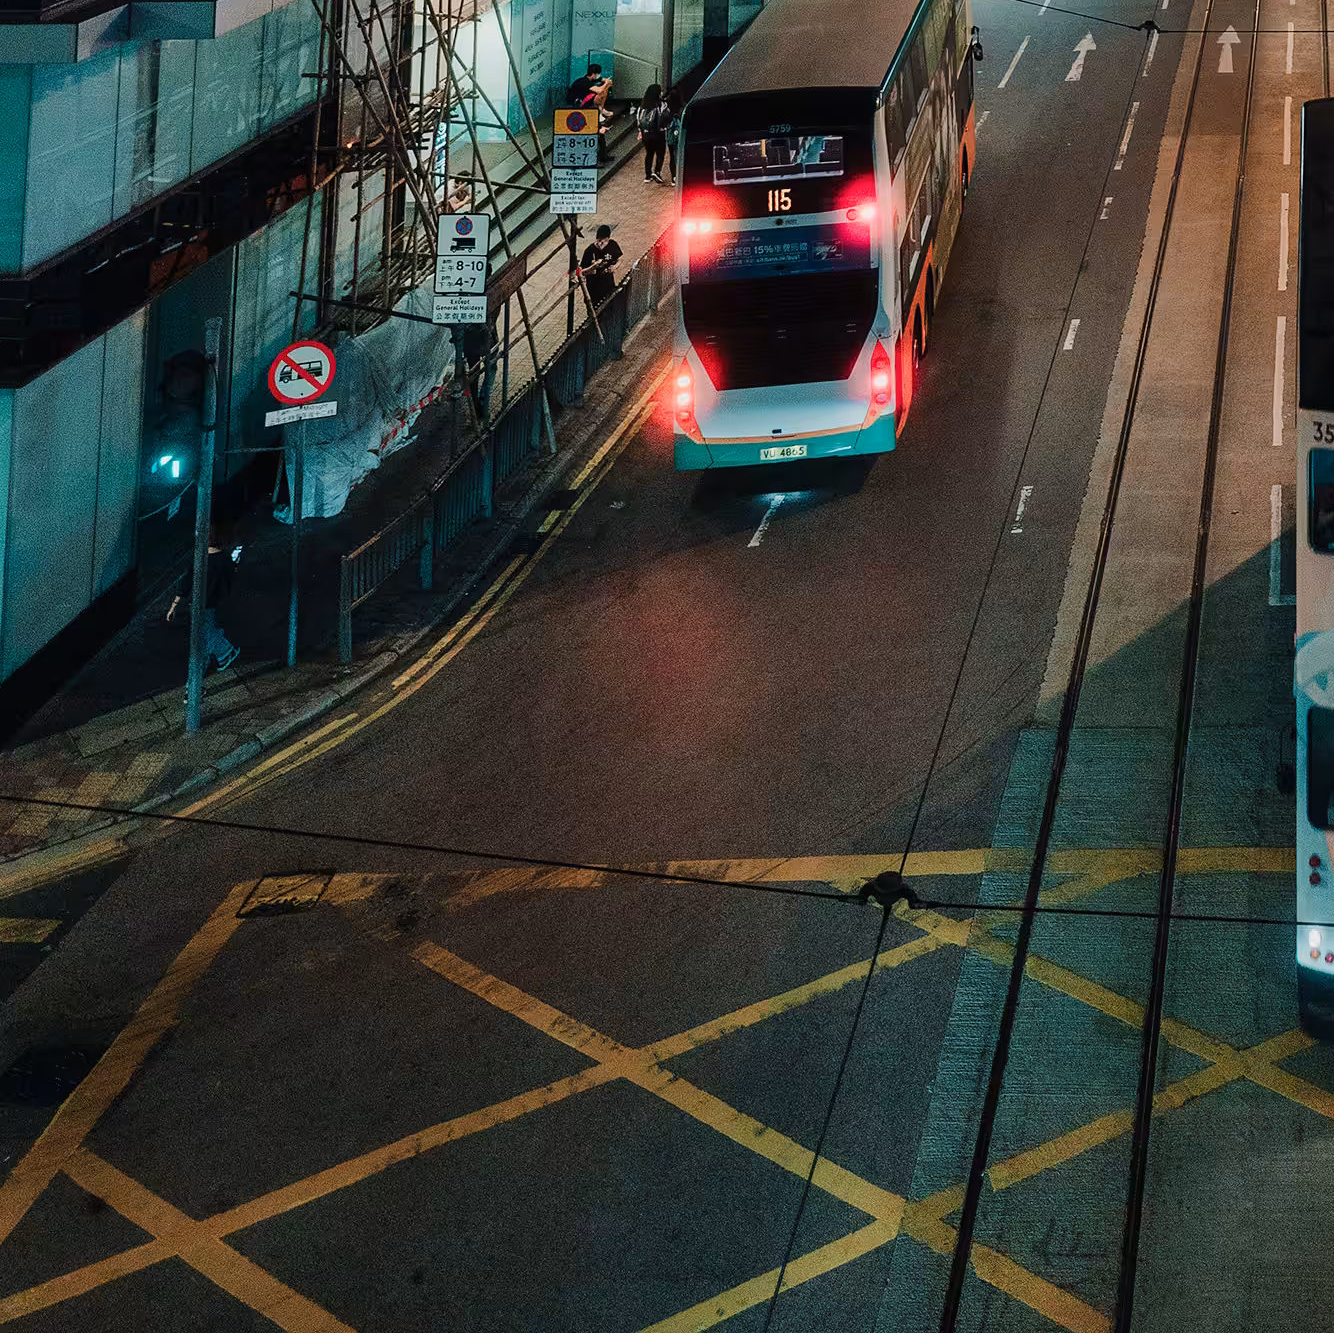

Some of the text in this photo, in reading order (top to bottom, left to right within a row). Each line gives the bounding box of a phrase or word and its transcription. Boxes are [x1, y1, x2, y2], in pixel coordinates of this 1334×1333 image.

[768, 123, 792, 134] 5759
[569, 138, 596, 148] 8-10
[569, 153, 588, 164] 5-7
[767, 188, 792, 213] 115
[456, 260, 484, 271] 8-10
[454, 277, 476, 288] 4-7
[1313, 421, 1334, 444] 35
[763, 450, 776, 459] VU
